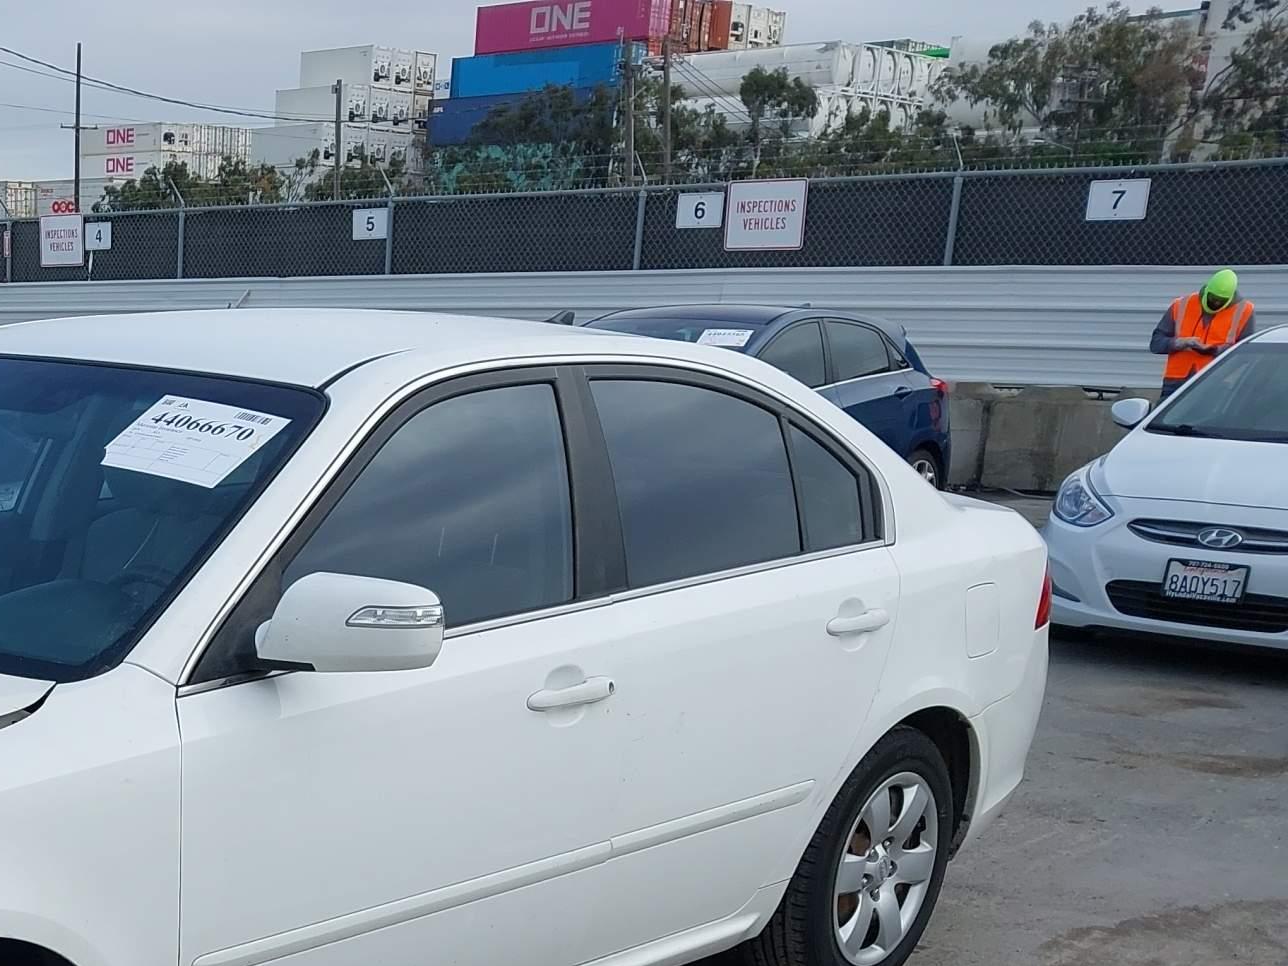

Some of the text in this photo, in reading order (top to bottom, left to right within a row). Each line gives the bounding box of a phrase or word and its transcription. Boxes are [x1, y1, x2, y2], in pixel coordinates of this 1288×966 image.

[530, 0, 591, 34] ONE
[106, 128, 134, 145] ONE
[106, 157, 134, 173] ONE
[736, 199, 797, 214] INSPECTIONS
[1111, 189, 1127, 210] 7
[694, 201, 706, 219] 6
[366, 216, 375, 231] 5
[742, 217, 787, 231] VEHICLES
[45, 228, 78, 240] INSPECTIONS
[95, 229, 103, 243] 4
[49, 241, 74, 252] VEHICLES
[151, 411, 255, 441] 44066670
